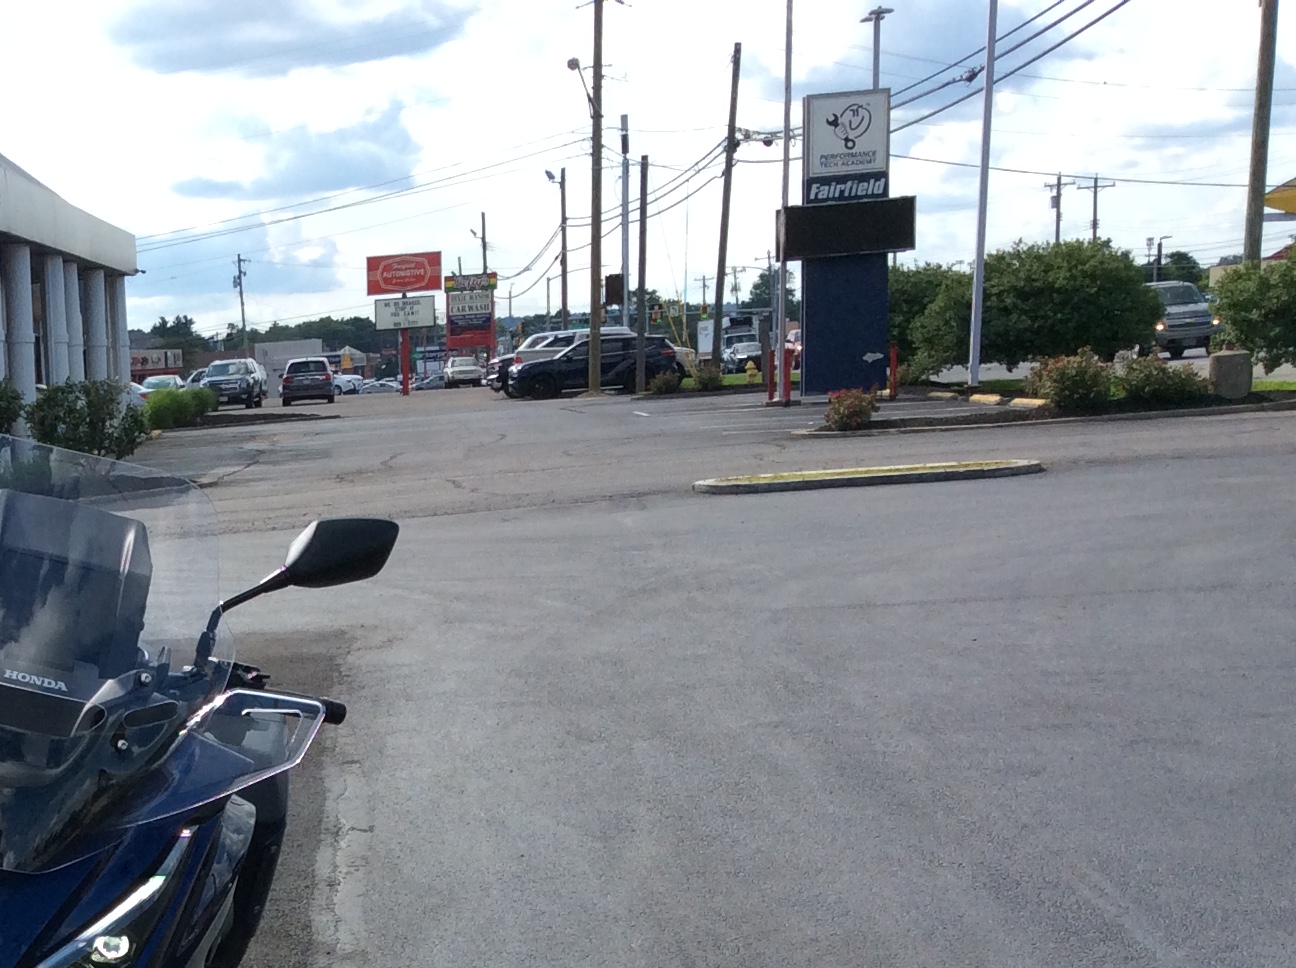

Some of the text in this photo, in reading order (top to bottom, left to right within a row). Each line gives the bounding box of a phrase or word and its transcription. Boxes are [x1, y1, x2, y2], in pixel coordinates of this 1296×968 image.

[819, 150, 876, 161] PERFORMANCE
[819, 158, 877, 168] TECH ACADEMY
[809, 178, 885, 199] Fairfield
[383, 268, 424, 278] AUTOMOTIVE
[451, 303, 490, 314] CAR WASH
[4, 668, 68, 692] HONDA
